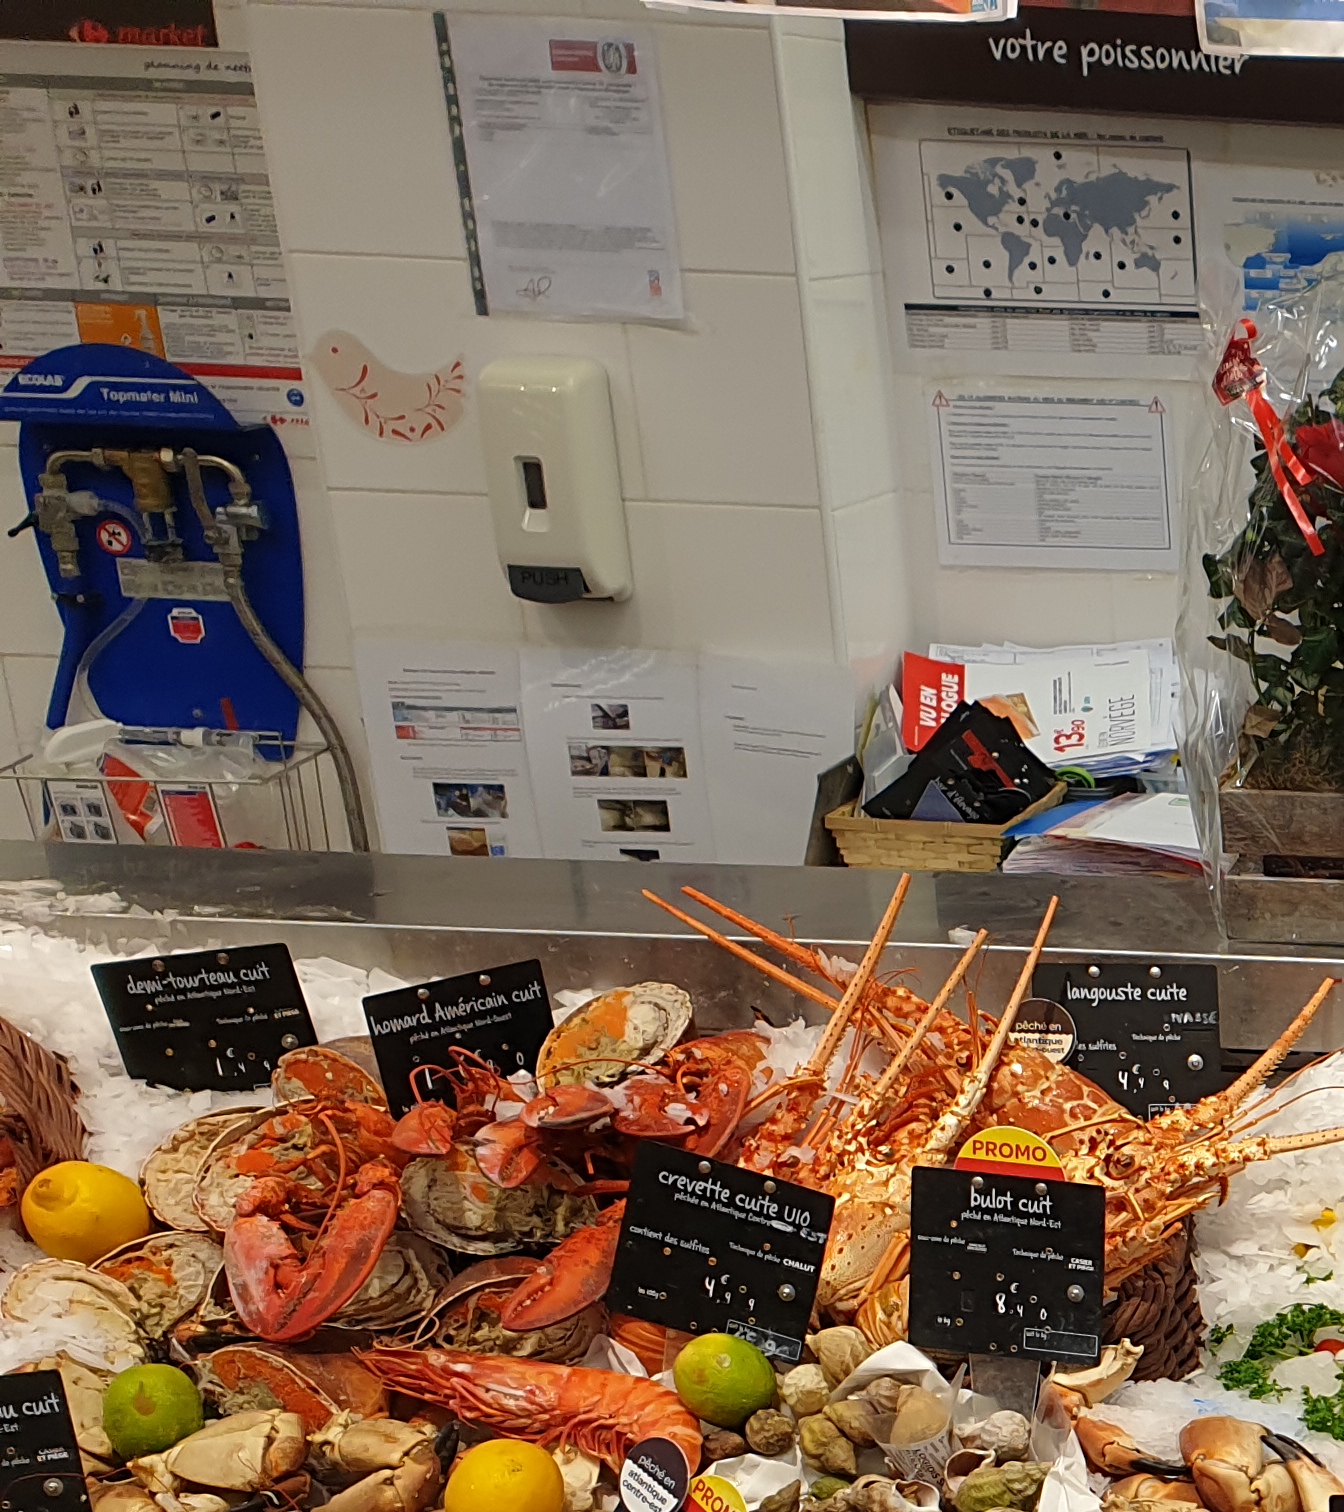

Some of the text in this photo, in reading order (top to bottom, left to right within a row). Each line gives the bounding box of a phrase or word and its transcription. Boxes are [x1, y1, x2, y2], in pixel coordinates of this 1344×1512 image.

[988, 28, 1068, 64] votre
[521, 570, 570, 586] PUSH
[919, 684, 938, 728] VU EN
[1053, 730, 1086, 754] 13
[126, 961, 272, 995] demi-tourteau cuit
[370, 980, 543, 1037] homard Américain cuit
[1066, 980, 1188, 1007] langouste cuite
[1048, 1022, 1062, 1032] en
[971, 1138, 1048, 1163] PROMO
[658, 1169, 812, 1227] crevette cuite U10
[970, 1185, 1053, 1215] bulot cuit
[782, 1256, 816, 1274] CHALUT
[22, 1392, 60, 1416] cuit
[627, 1469, 668, 1506] atlantique
[637, 1455, 677, 1490] pêché en
